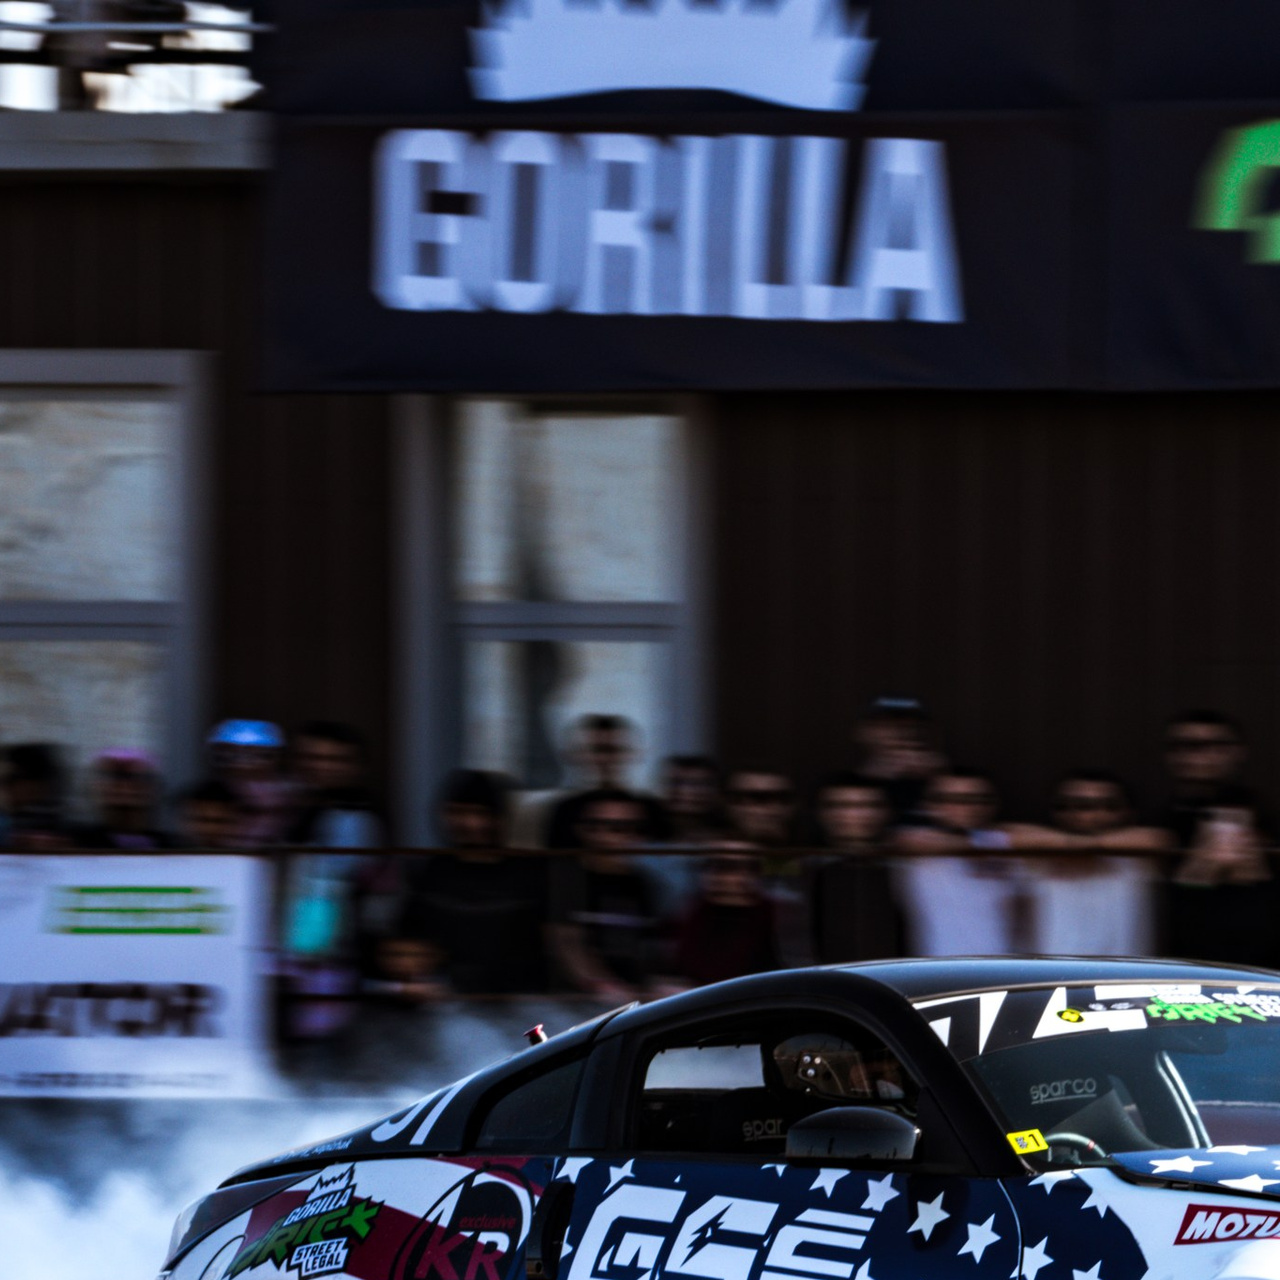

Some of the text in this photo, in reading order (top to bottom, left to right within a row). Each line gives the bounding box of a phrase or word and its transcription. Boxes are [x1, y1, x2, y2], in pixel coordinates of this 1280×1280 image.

[375, 129, 964, 322] GORILLA
[1030, 1078, 1097, 1104] sparco
[743, 1118, 788, 1142] spar
[282, 1188, 352, 1227] GORILLA
[459, 1214, 517, 1229] exclusive
[295, 1240, 343, 1261] STREET
[304, 1254, 342, 1273] LEGAL
